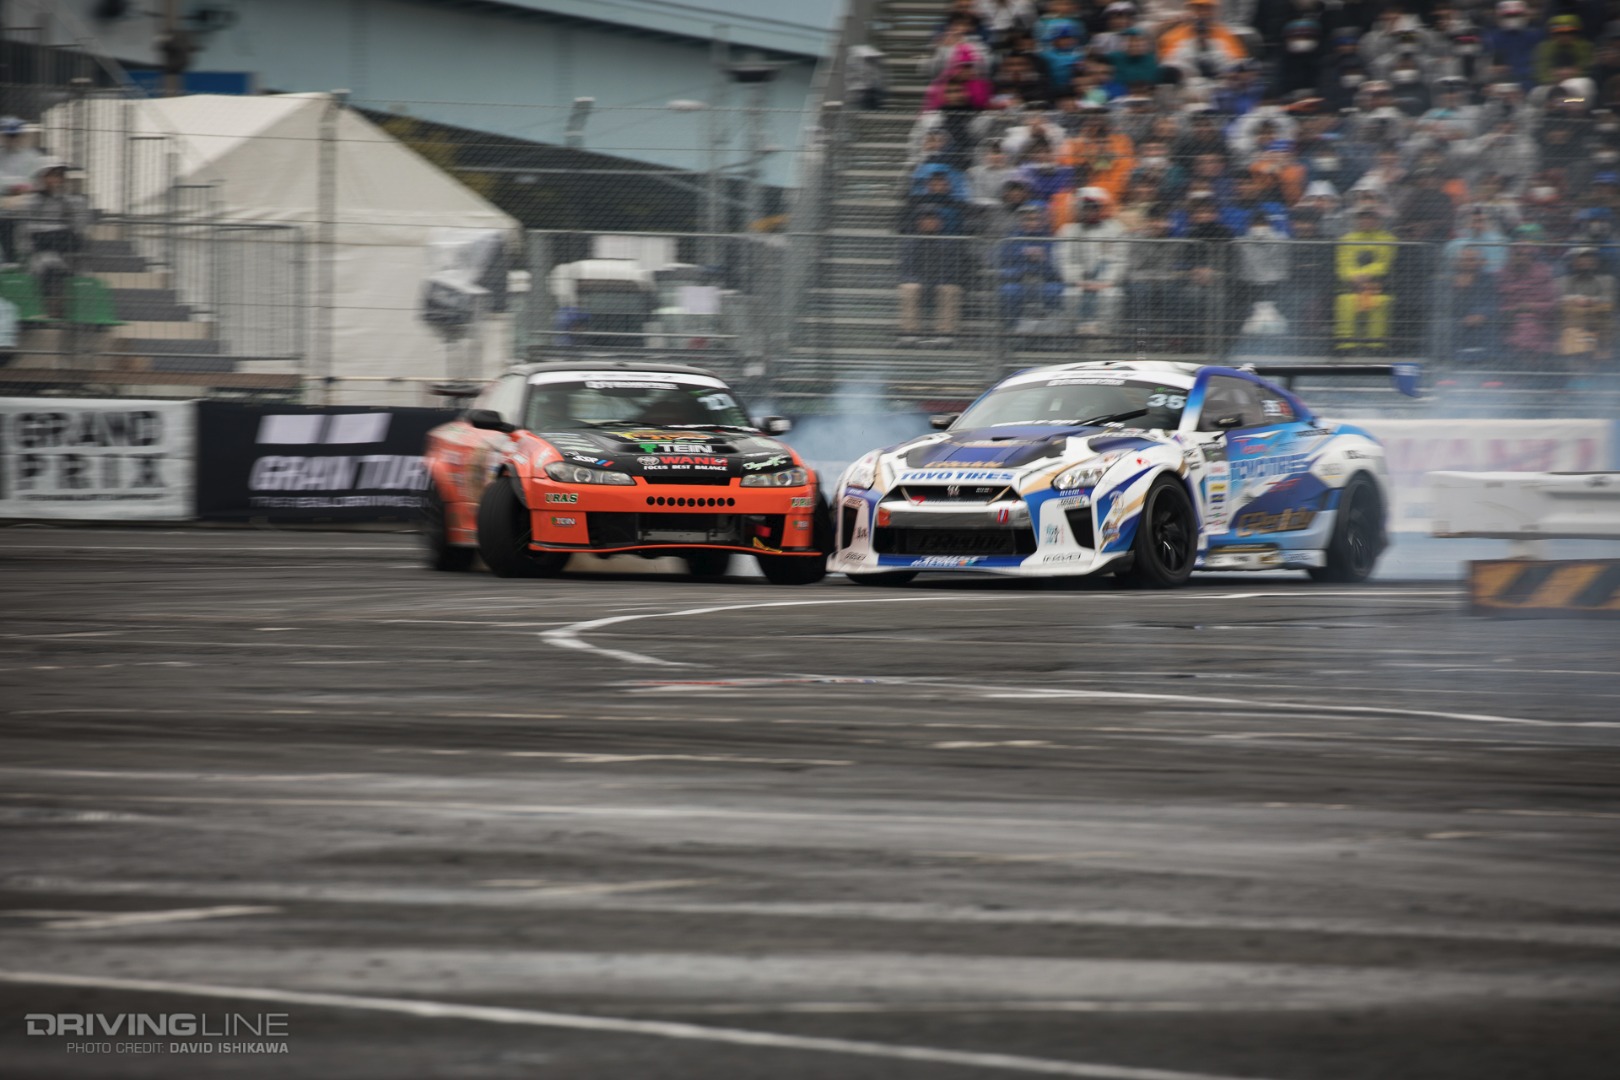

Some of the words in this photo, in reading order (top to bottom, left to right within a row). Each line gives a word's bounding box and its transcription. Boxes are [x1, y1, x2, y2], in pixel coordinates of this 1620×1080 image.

[1147, 394, 1187, 409] 35
[659, 444, 713, 453] TEIN
[17, 453, 168, 489] PRIX
[248, 455, 354, 490] GRAN
[900, 471, 953, 481] TOYO
[955, 471, 1016, 481] TIRES
[545, 493, 578, 504] URAS
